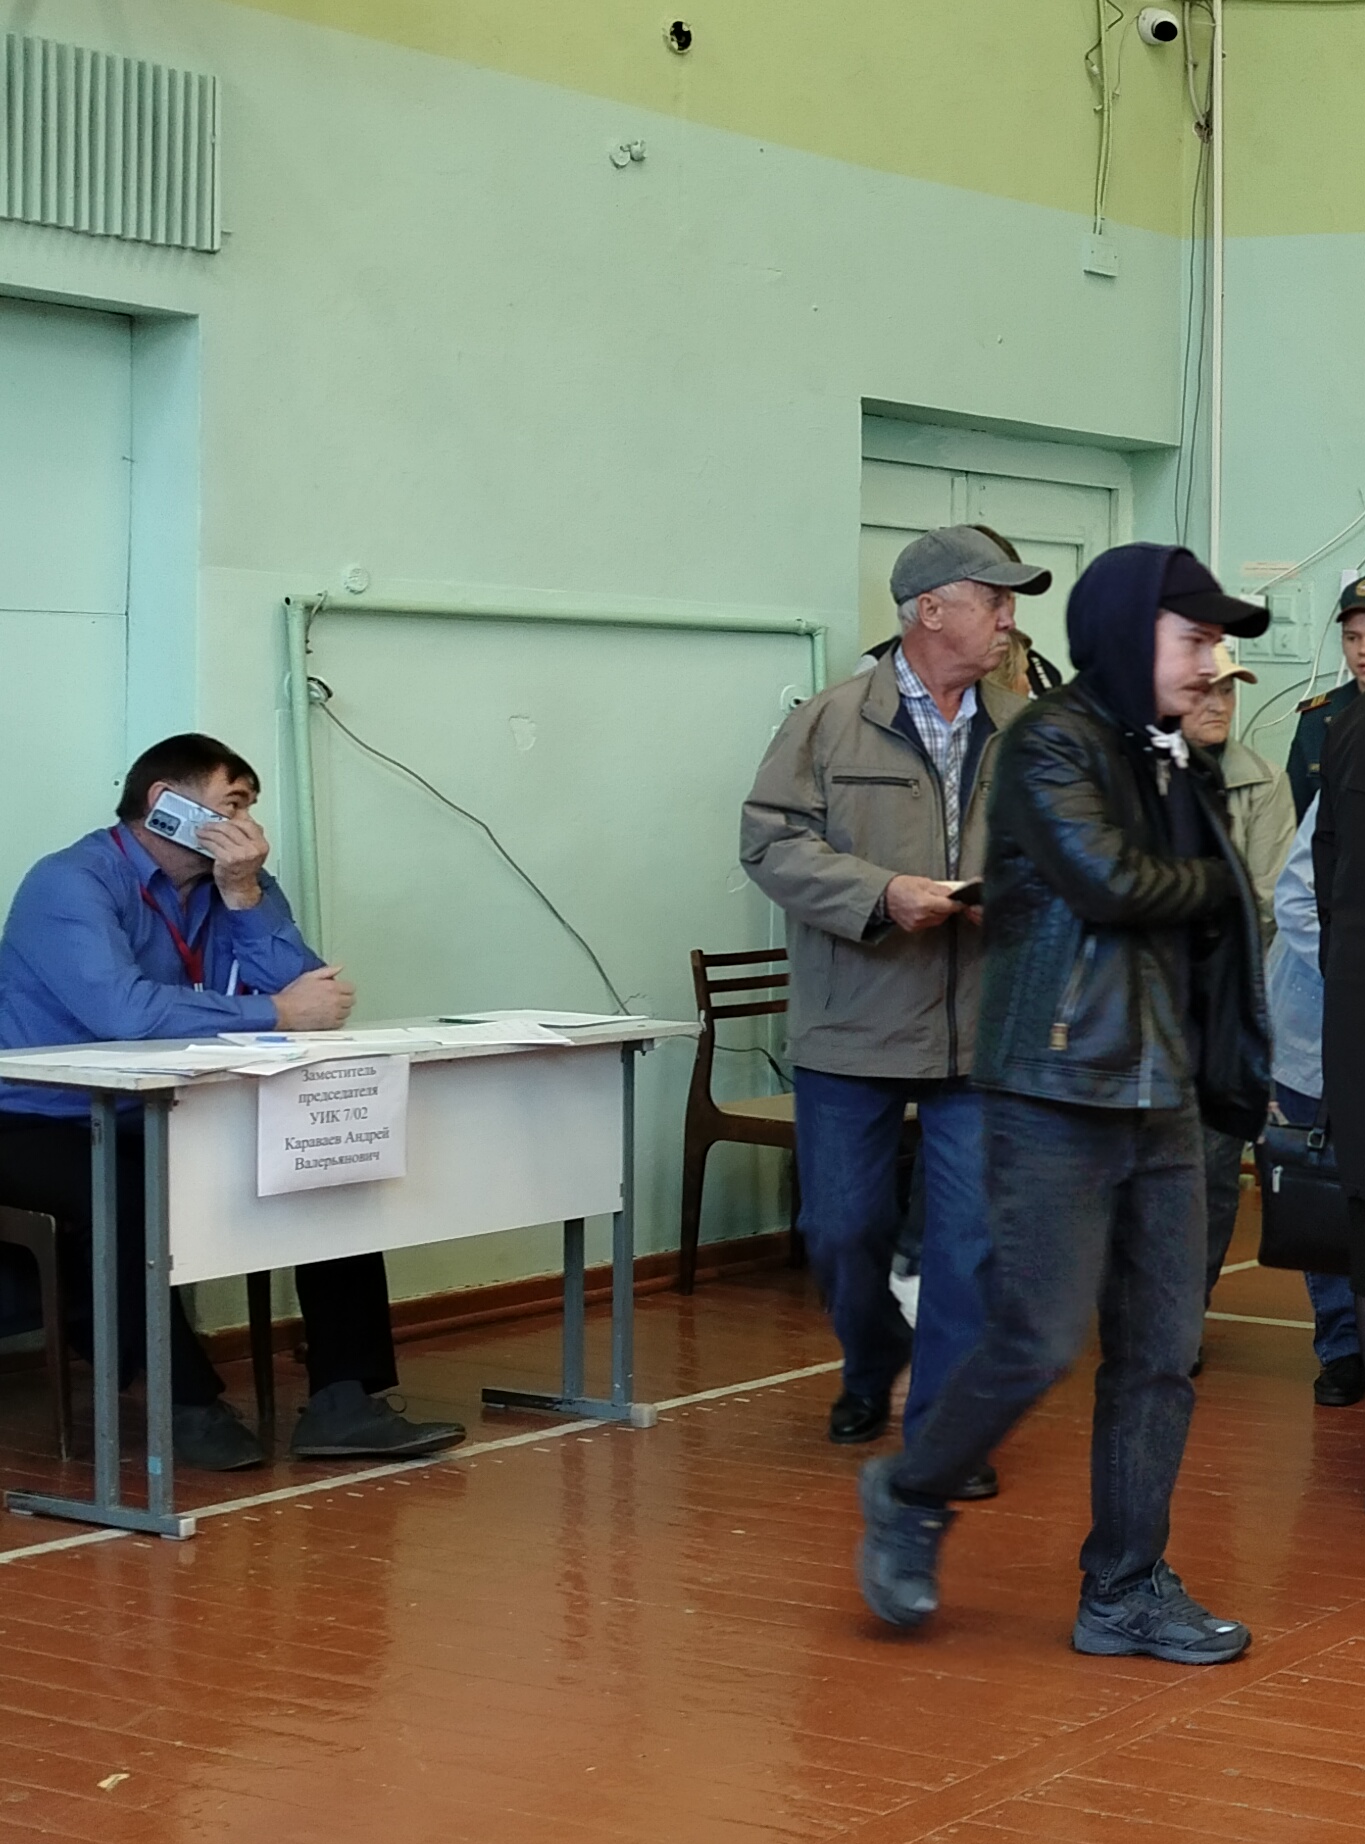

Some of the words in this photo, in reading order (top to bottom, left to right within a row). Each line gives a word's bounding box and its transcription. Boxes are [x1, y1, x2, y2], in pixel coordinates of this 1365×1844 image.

[301, 1066, 377, 1082] Заместитель
[298, 1086, 379, 1106] председателя
[310, 1109, 341, 1125] УИК
[344, 1107, 368, 1122] 7/02
[285, 1134, 342, 1152] Караваев
[344, 1127, 390, 1145] Андрей
[294, 1151, 380, 1171] Валерьянович
